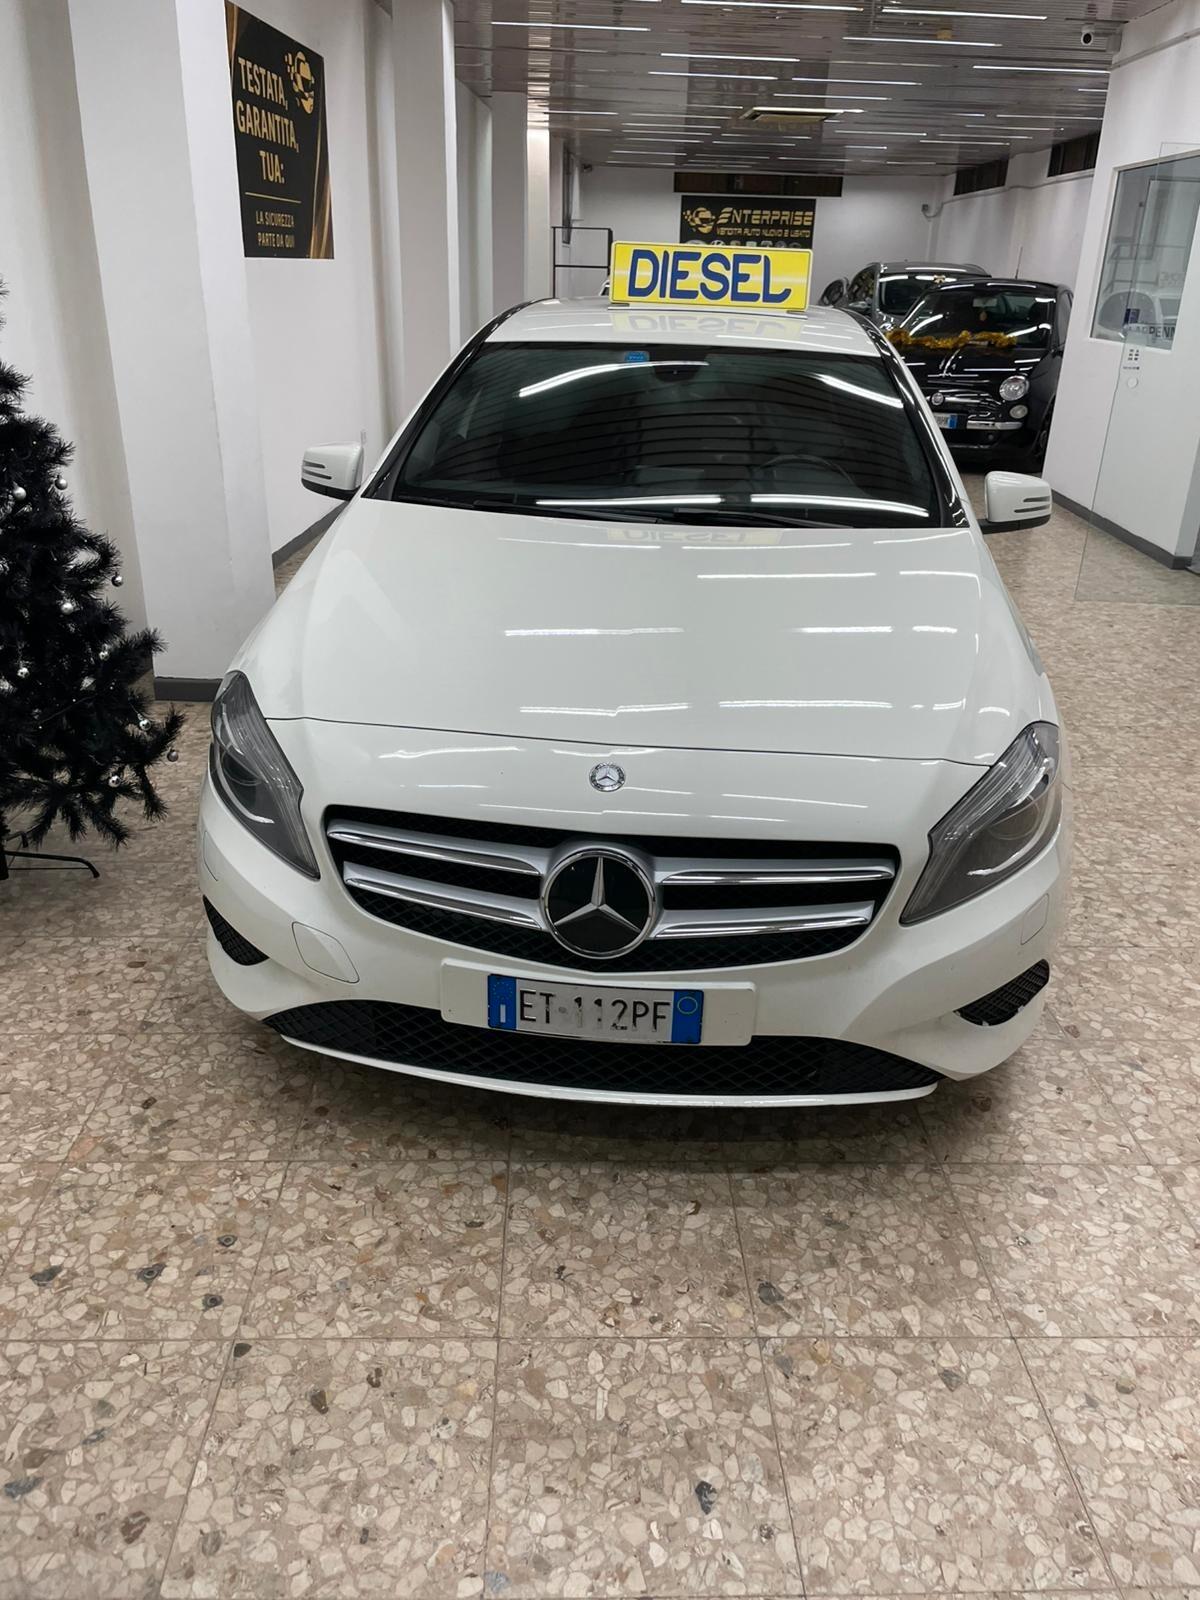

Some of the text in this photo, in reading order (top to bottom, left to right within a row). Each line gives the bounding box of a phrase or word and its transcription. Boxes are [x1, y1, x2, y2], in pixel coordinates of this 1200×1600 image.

[238, 57, 288, 110] TESTATA,
[236, 100, 299, 152] GARANTITA,
[259, 150, 285, 184] TUA:
[256, 210, 295, 228] LA SICUREZZA
[717, 207, 813, 225] ENTERPRISE
[257, 232, 295, 248] PARTE DA QUI
[743, 227, 761, 236] AUTO
[762, 228, 783, 237] NUOVO
[628, 248, 792, 303] DIESEL
